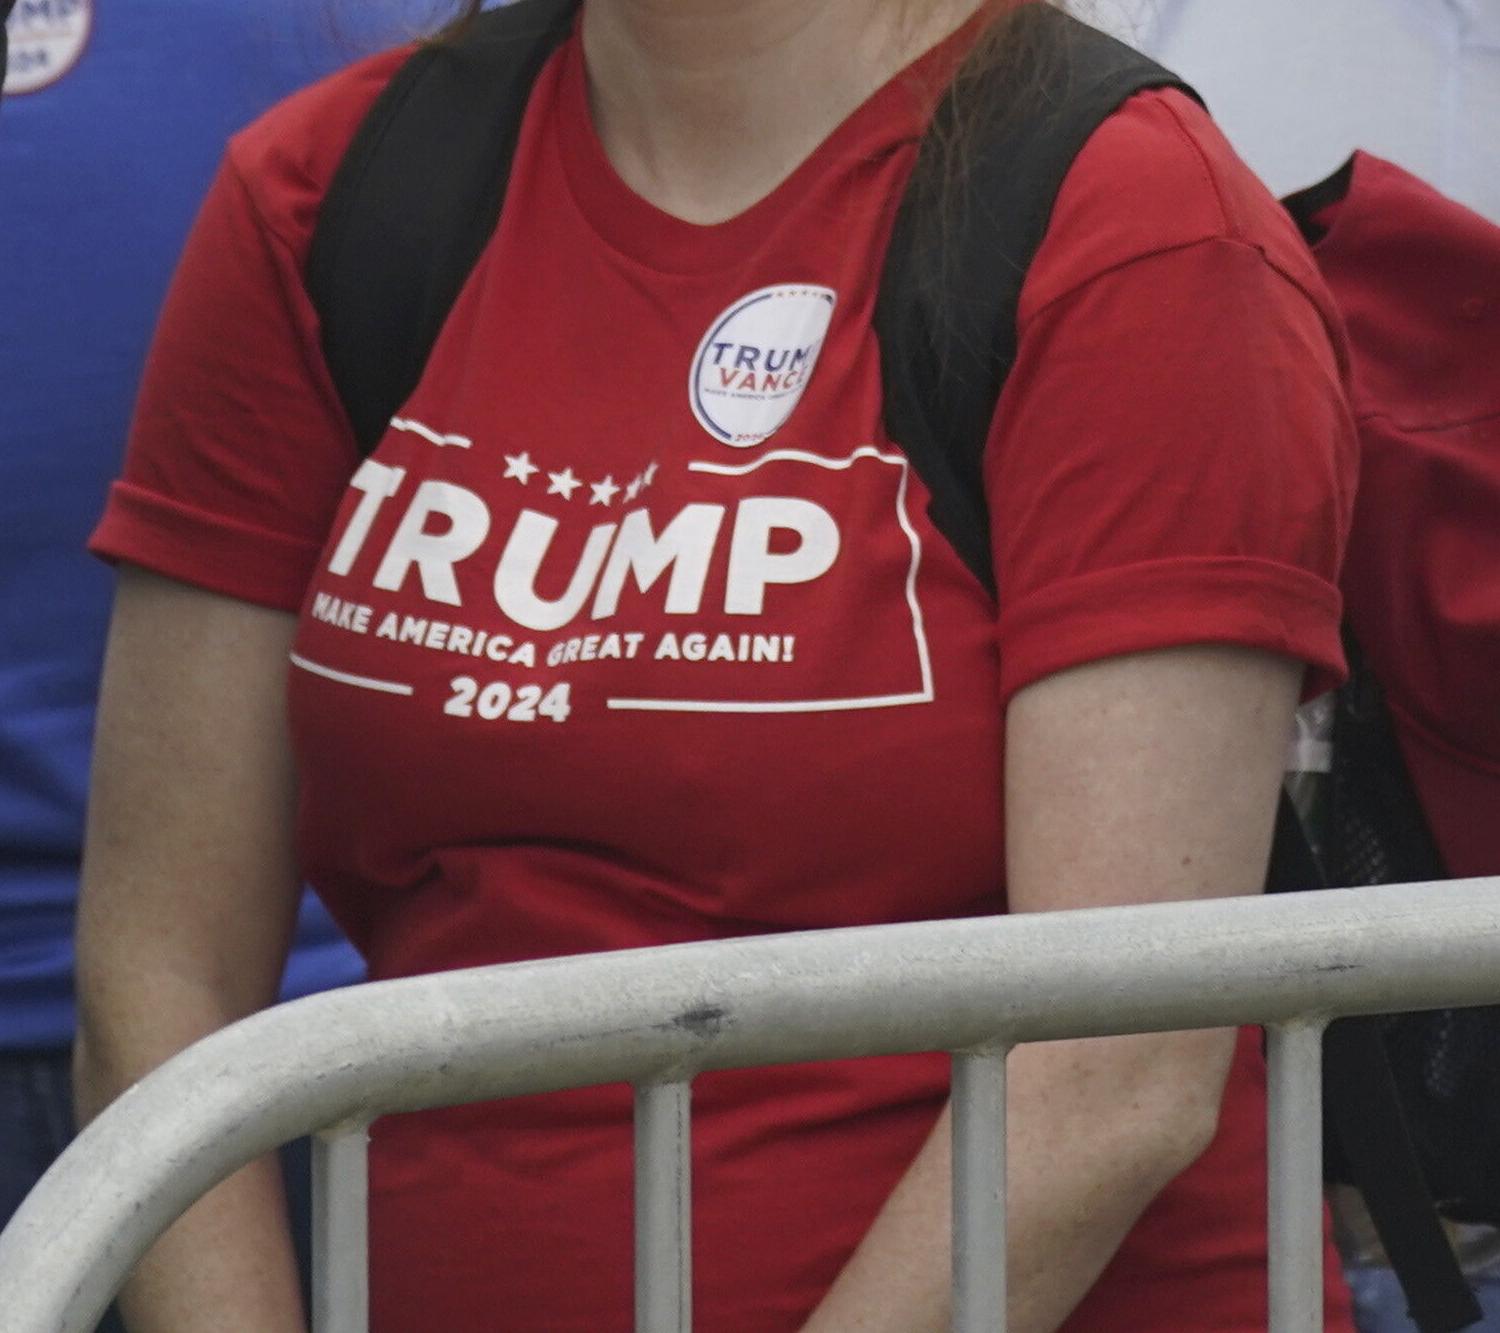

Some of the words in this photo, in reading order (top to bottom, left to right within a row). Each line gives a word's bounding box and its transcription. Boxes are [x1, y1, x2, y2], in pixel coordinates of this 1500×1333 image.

[712, 342, 814, 373] TRUM
[326, 459, 841, 631] TRUMP
[311, 591, 370, 635] MAKE
[376, 612, 537, 668] AMERICA
[546, 632, 642, 668] GREAT
[654, 634, 796, 664] AGAIN!
[443, 675, 572, 723] 2024
